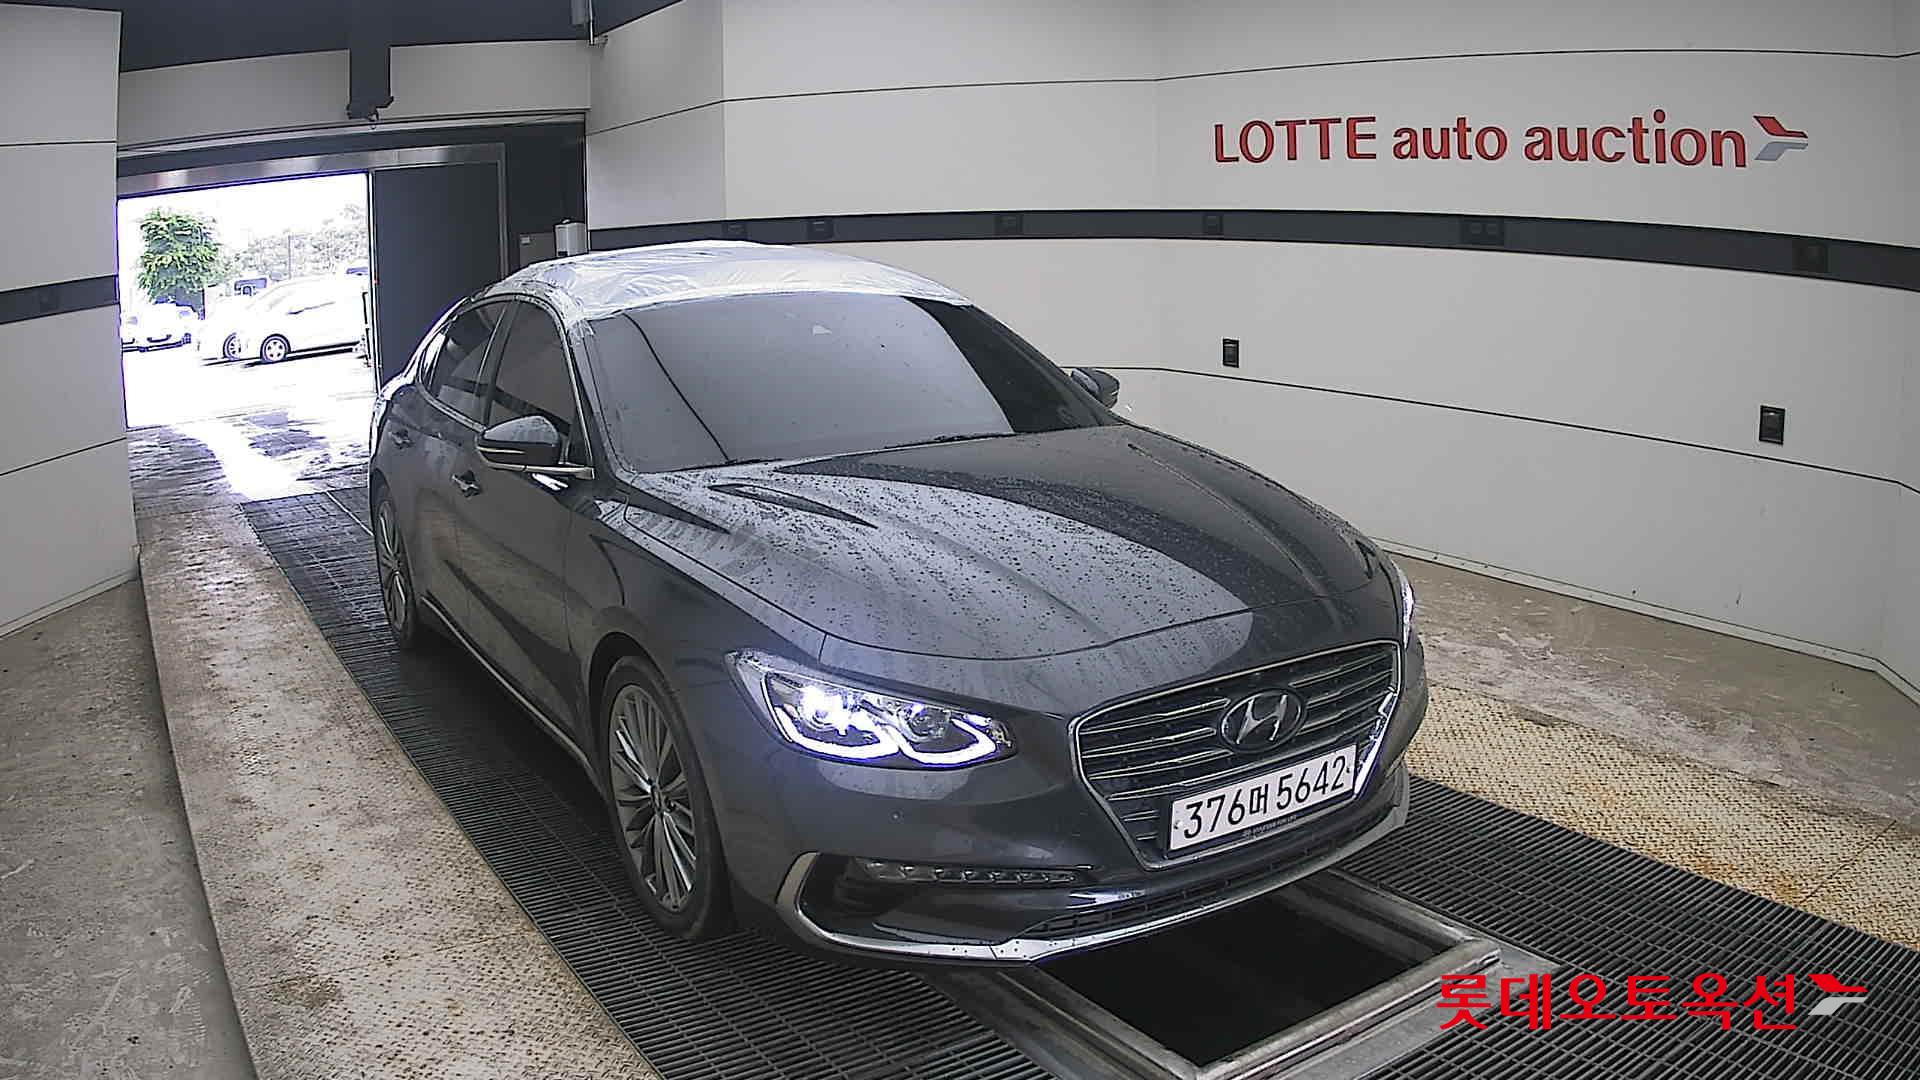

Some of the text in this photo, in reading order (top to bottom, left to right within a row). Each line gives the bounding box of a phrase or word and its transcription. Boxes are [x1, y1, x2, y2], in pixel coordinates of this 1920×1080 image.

[1214, 109, 1747, 168] LOTTE auto auction
[1276, 755, 1346, 810] 5642
